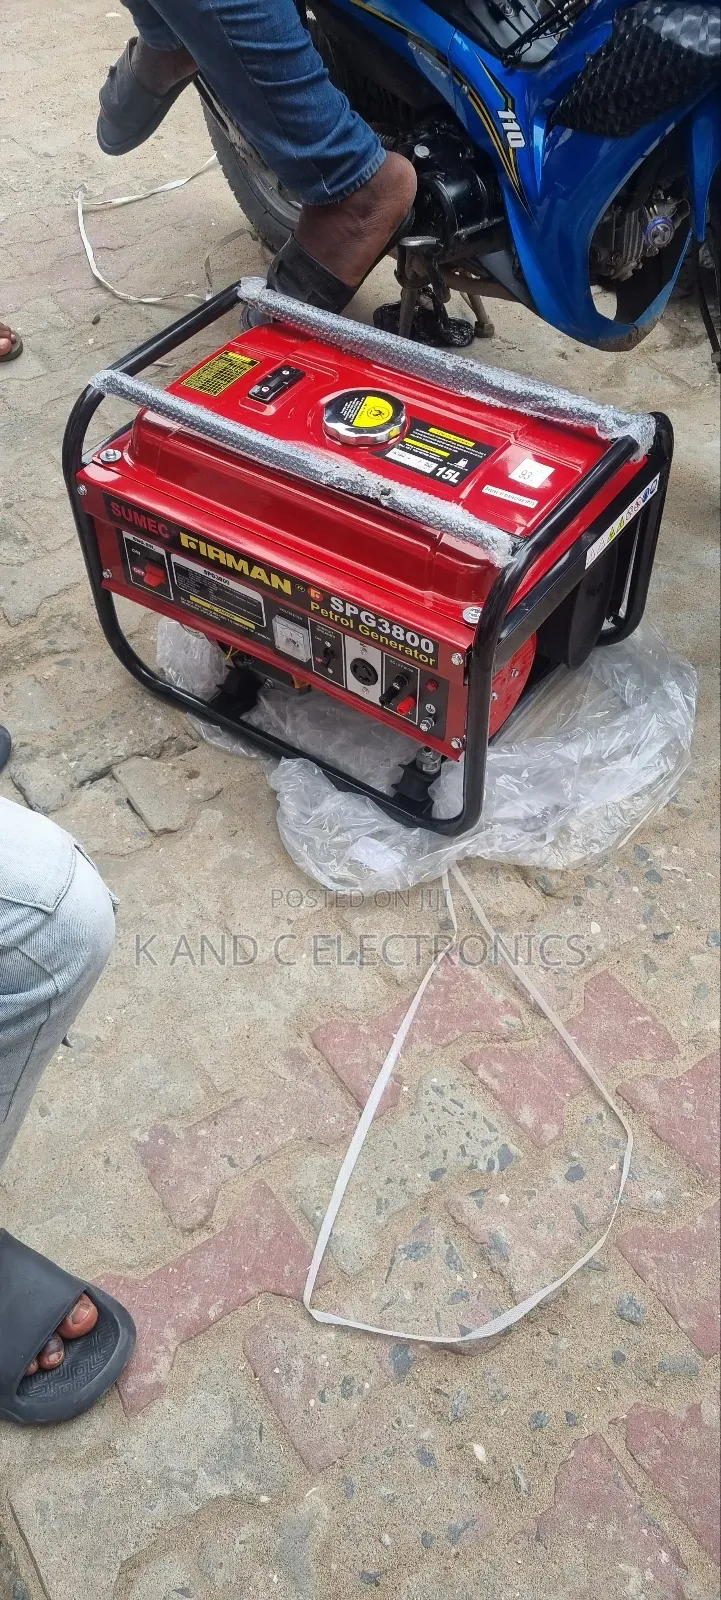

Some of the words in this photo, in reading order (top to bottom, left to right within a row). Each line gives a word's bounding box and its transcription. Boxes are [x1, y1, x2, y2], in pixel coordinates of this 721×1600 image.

[497, 109, 526, 148] 110
[435, 466, 461, 483] 15L
[110, 502, 170, 539] SUMEC
[179, 532, 292, 595] FIRMAN
[310, 601, 354, 629] Petrol
[358, 624, 436, 667] Generator
[330, 596, 435, 654] SPG3800
